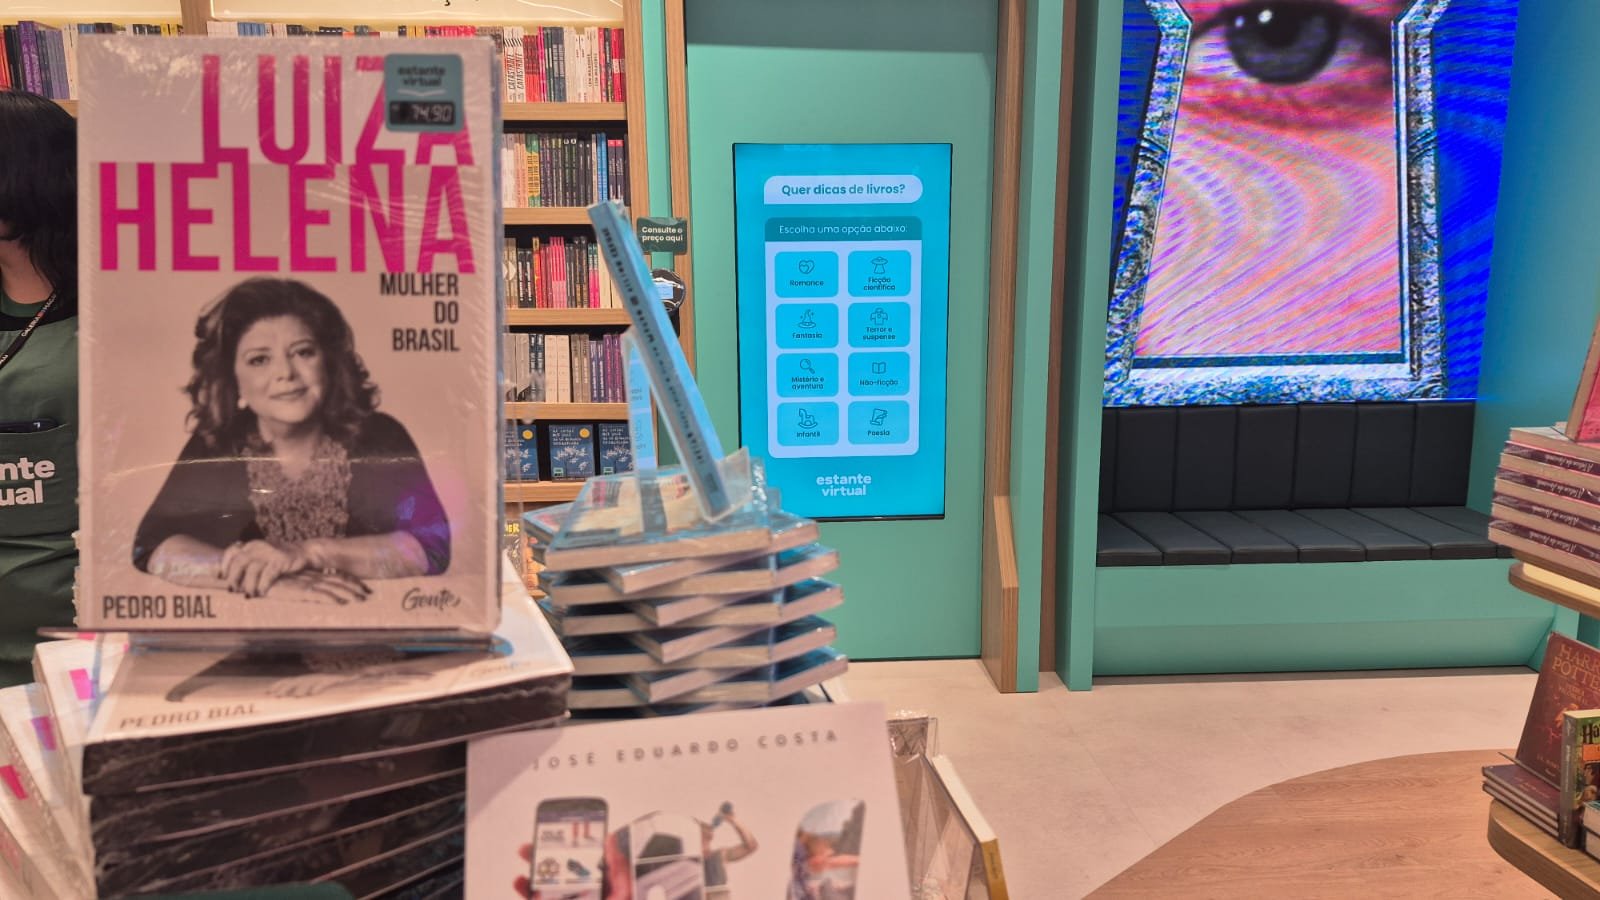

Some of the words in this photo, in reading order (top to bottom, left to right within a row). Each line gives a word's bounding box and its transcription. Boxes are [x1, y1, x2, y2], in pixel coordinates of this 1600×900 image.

[398, 66, 446, 76] estante
[403, 78, 442, 87] virtual
[781, 184, 811, 196] Quer
[813, 183, 847, 195] dicas
[849, 183, 864, 194] de
[866, 183, 905, 195] livros?
[100, 163, 476, 273] HELENA
[641, 226, 676, 234] Consulte
[779, 225, 815, 234] Escolha
[841, 224, 871, 235] opção
[642, 235, 664, 243] preço
[665, 234, 683, 243] aqui
[380, 273, 459, 296] MULHER
[789, 279, 824, 287] Romance
[868, 276, 891, 285] Ficção
[434, 301, 459, 324] DO
[392, 328, 460, 352] BRASIL
[859, 378, 898, 387] Não-ficção
[816, 474, 872, 485] estante
[822, 485, 867, 496] virtual
[103, 595, 166, 619] PEDRO
[173, 595, 216, 618] BIAL
[120, 708, 201, 729] PEDRO
[206, 703, 260, 718] BIAL
[616, 738, 739, 763] EDUARDO
[757, 729, 836, 749] COSTA
